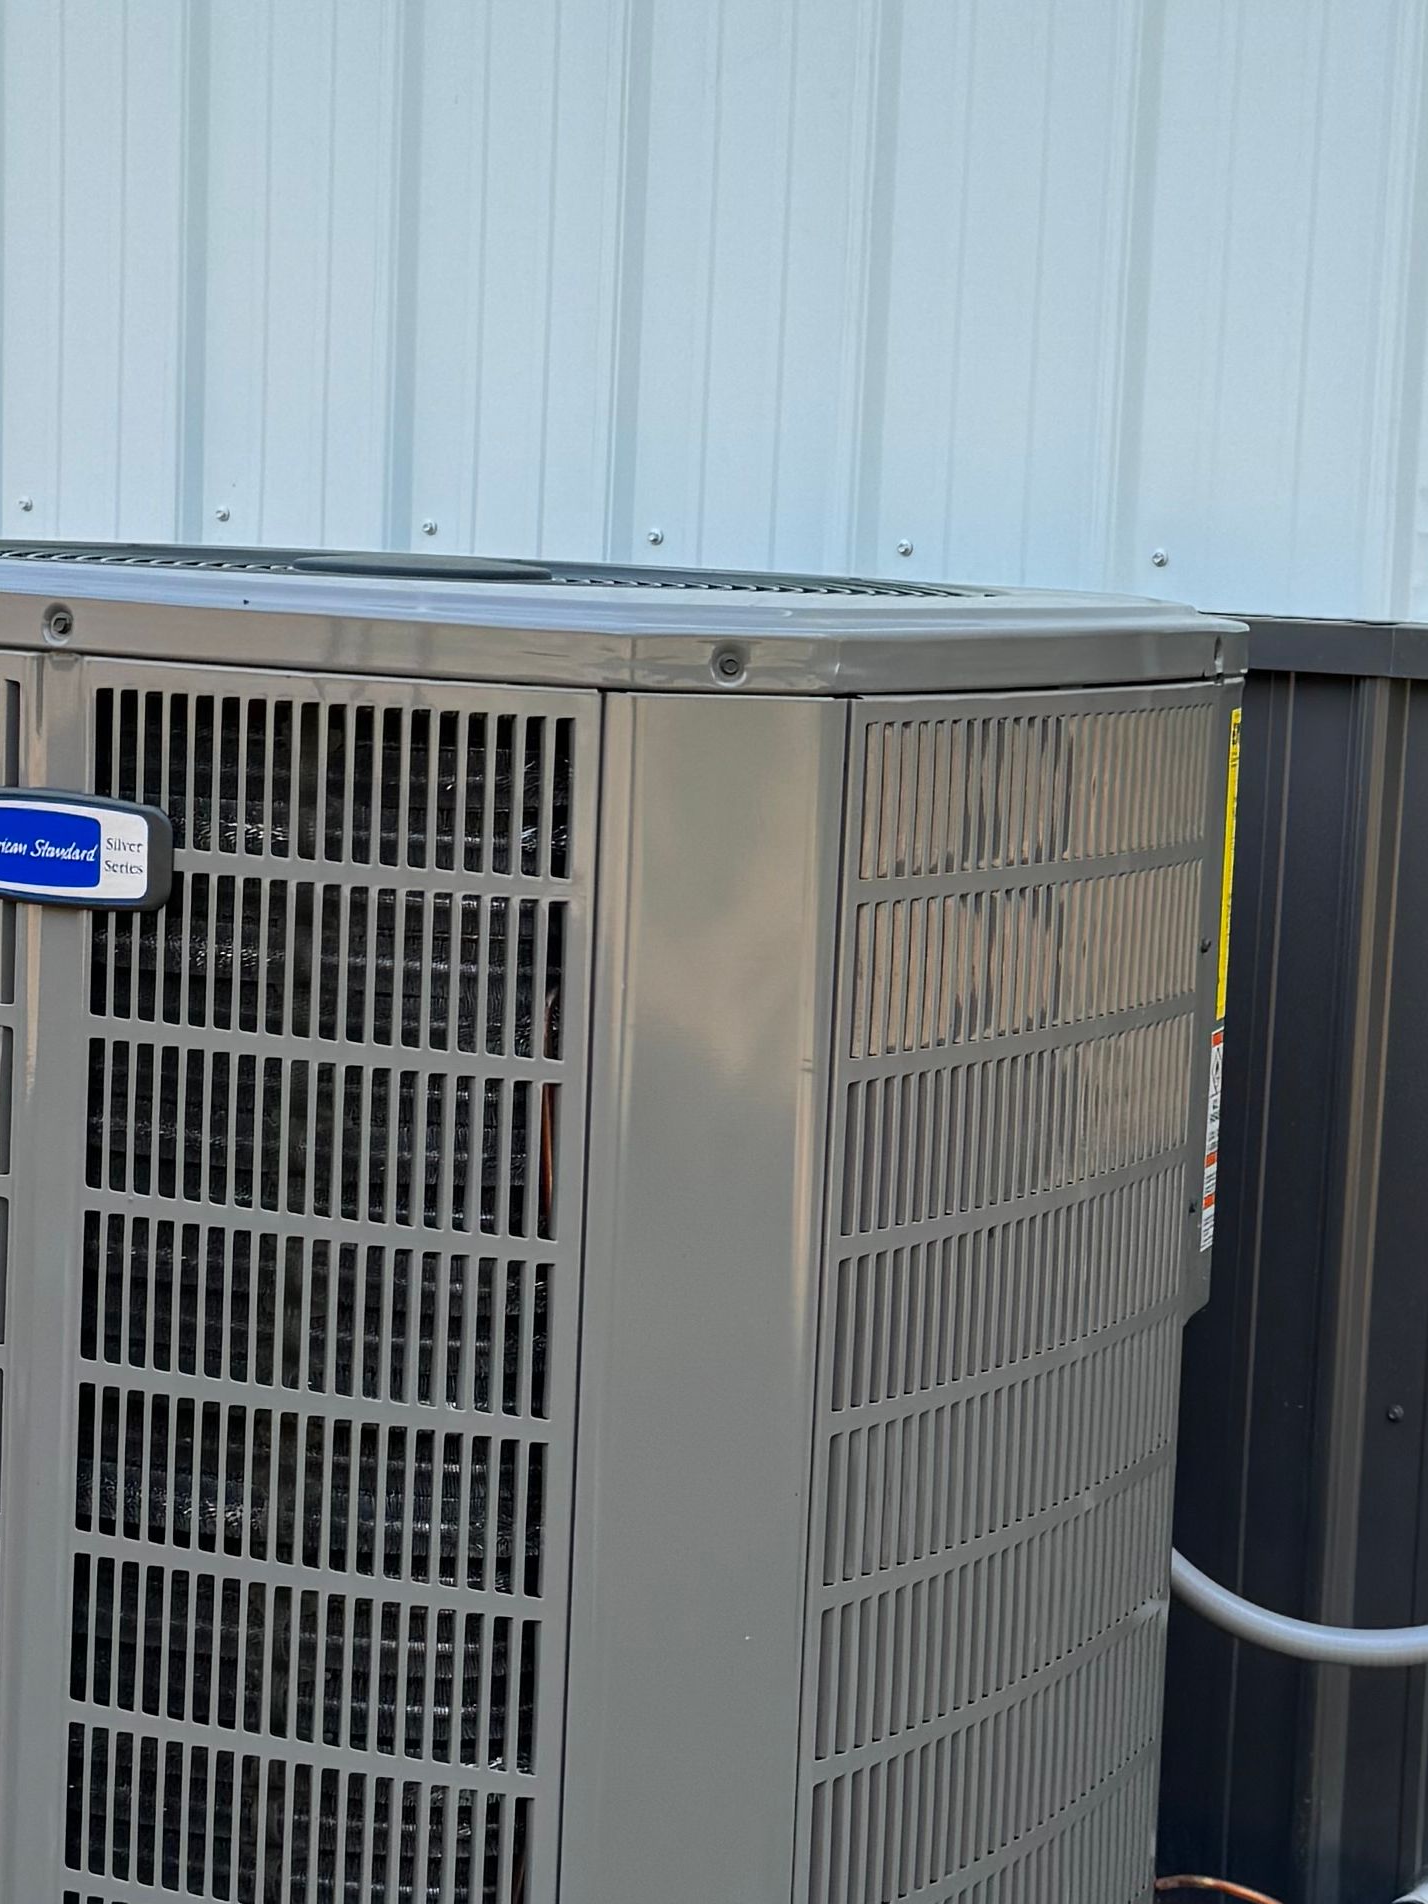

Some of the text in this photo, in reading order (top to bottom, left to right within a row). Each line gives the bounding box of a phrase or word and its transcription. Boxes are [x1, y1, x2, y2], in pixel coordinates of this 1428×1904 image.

[30, 839, 98, 861] Standard
[106, 837, 143, 853] Silver
[104, 860, 143, 875] Series
